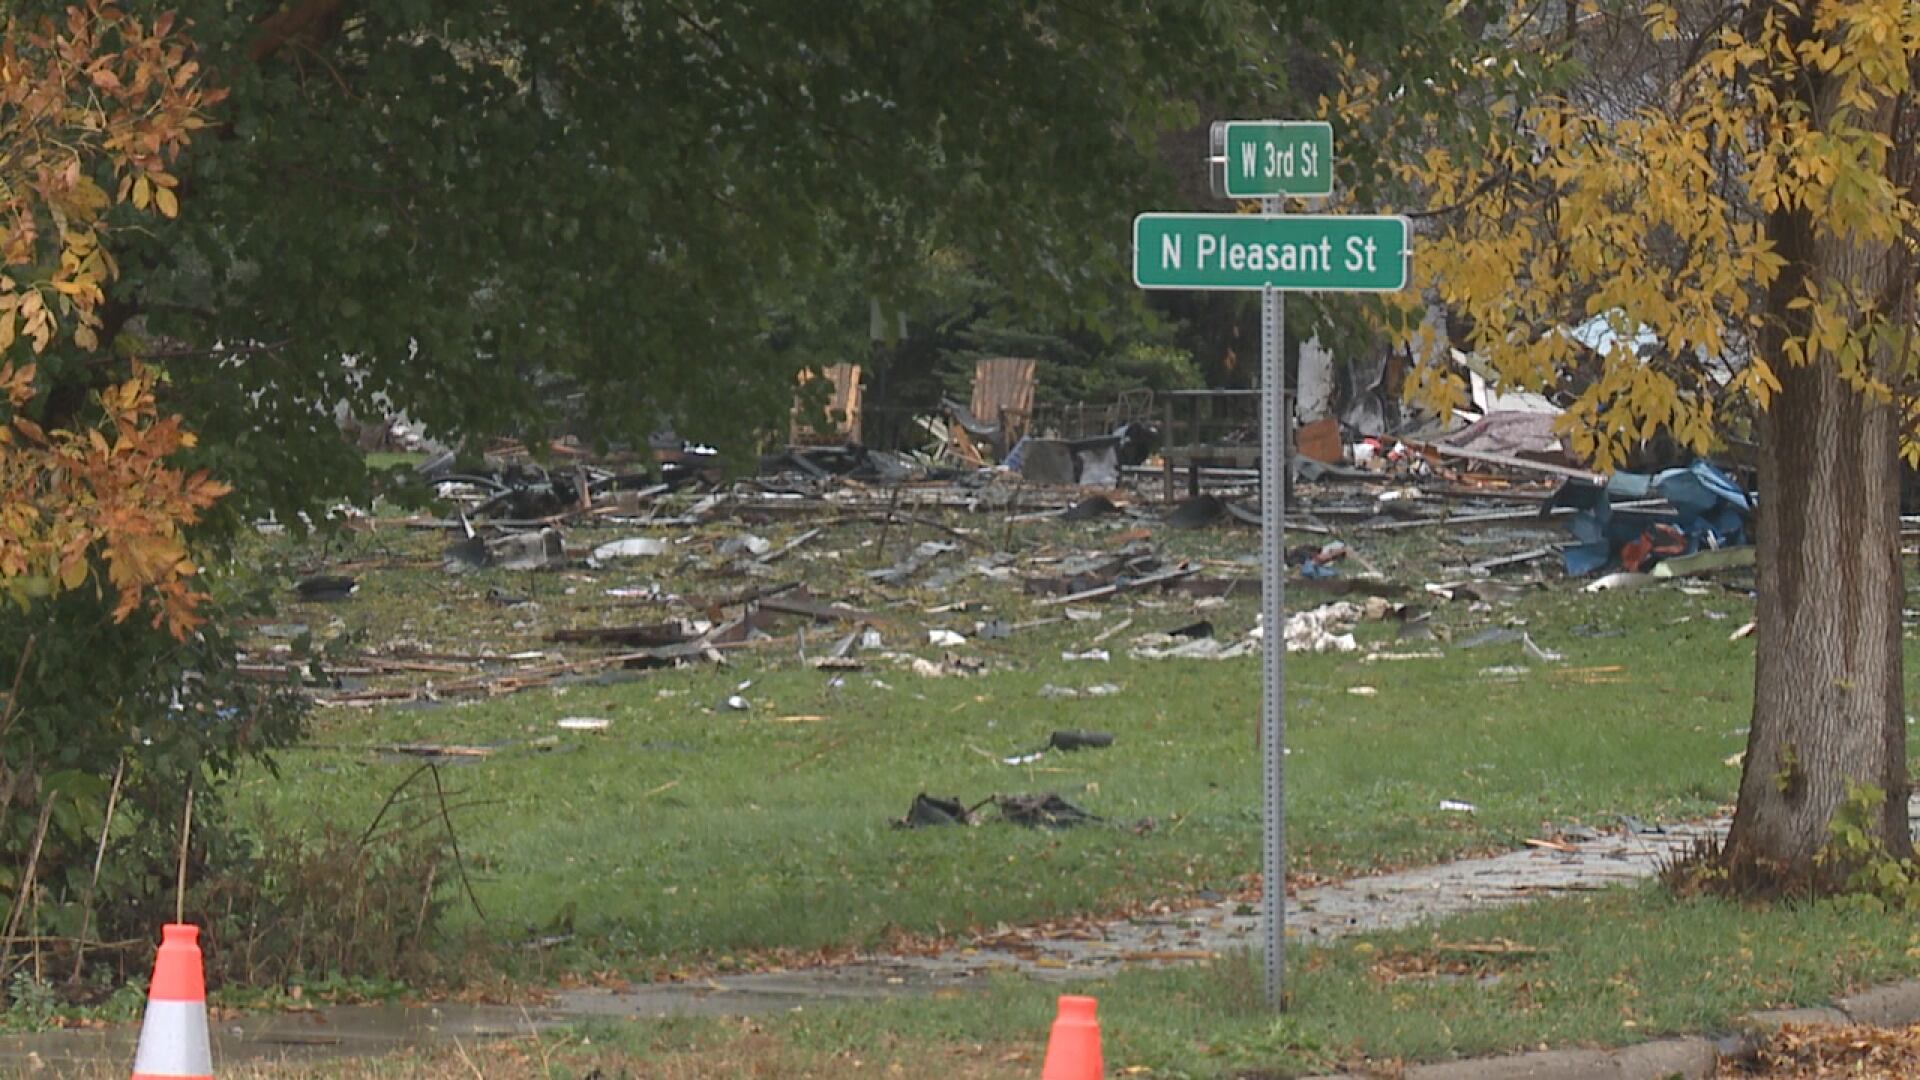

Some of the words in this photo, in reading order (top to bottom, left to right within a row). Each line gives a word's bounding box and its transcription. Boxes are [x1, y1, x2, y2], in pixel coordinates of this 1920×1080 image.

[1241, 141, 1257, 177] W
[1264, 141, 1294, 178] 3rd
[1301, 141, 1319, 178] St
[1161, 233, 1181, 269] N
[1197, 233, 1331, 271] Pleasant
[1344, 236, 1377, 273] St
